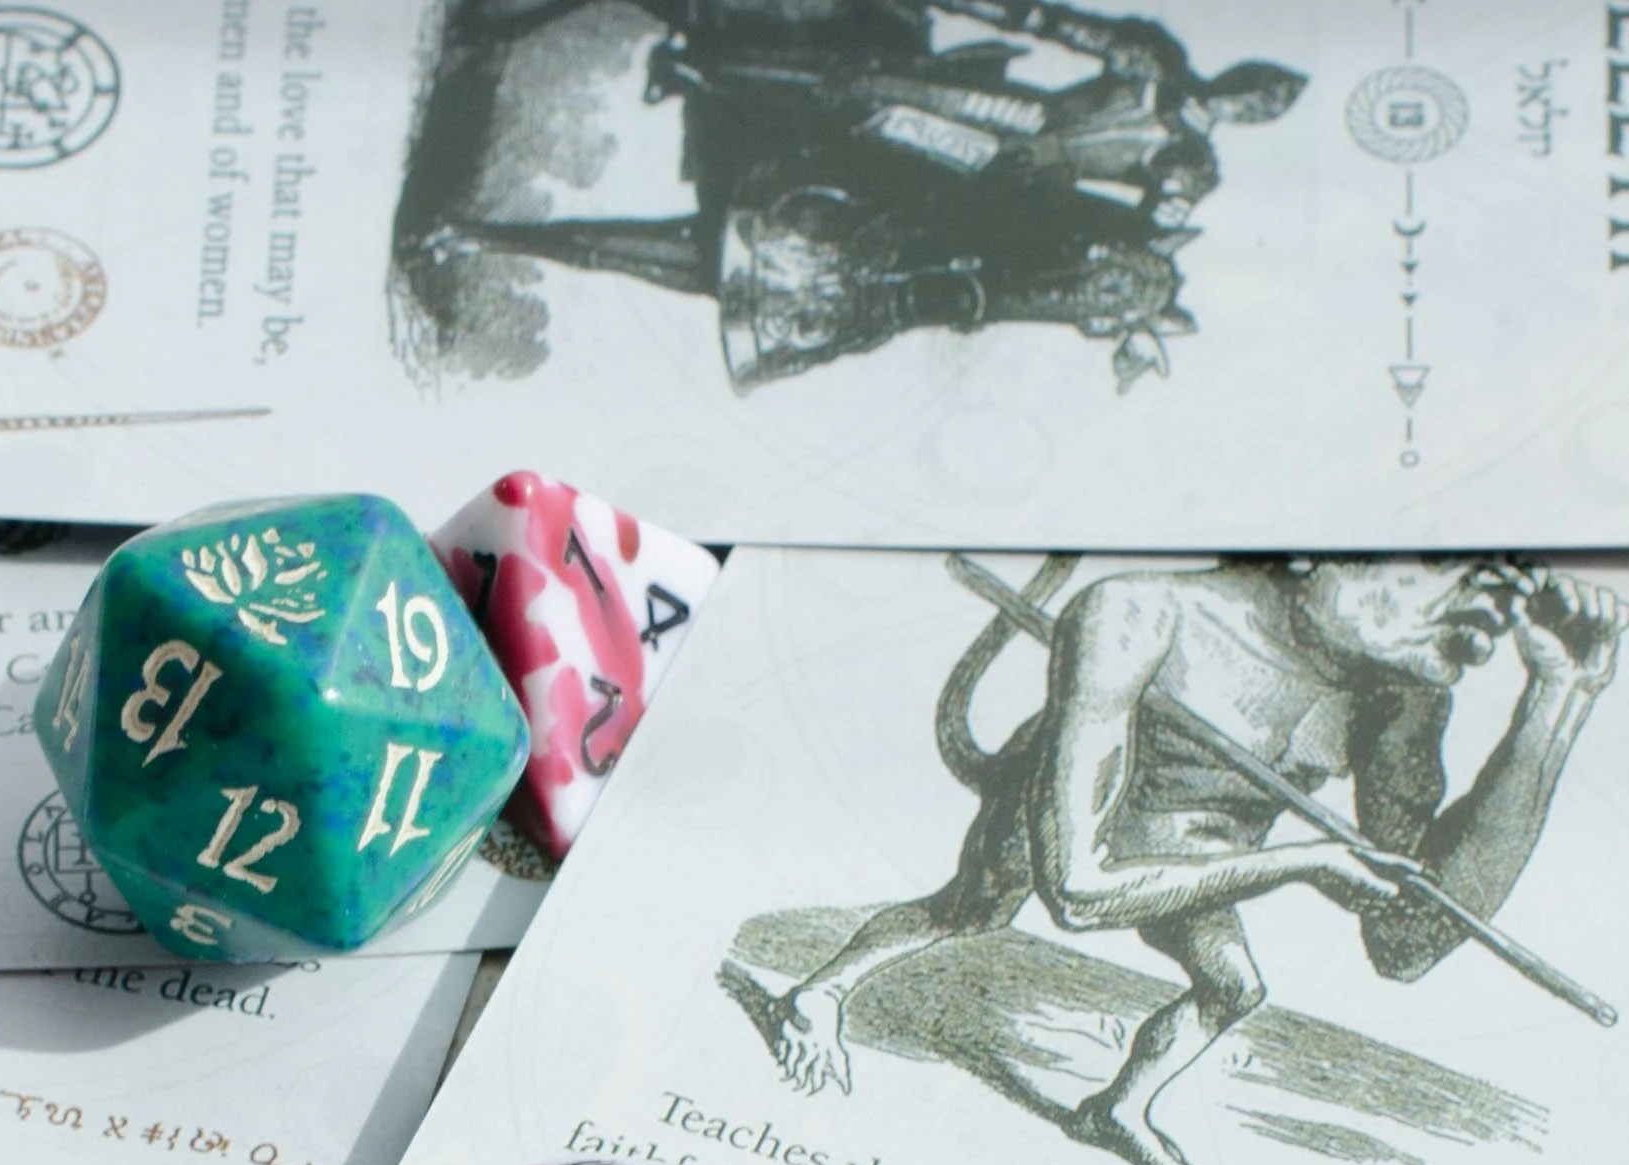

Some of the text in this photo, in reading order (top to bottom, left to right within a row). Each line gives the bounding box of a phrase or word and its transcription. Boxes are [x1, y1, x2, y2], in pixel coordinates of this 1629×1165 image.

[212, 71, 255, 136] and
[208, 145, 251, 185] of
[251, 6, 327, 367] the love that may be,
[196, 190, 234, 329] women.
[375, 580, 449, 692] 19
[196, 783, 301, 895] 12
[357, 741, 444, 857] 11
[159, 969, 276, 1020] dead.
